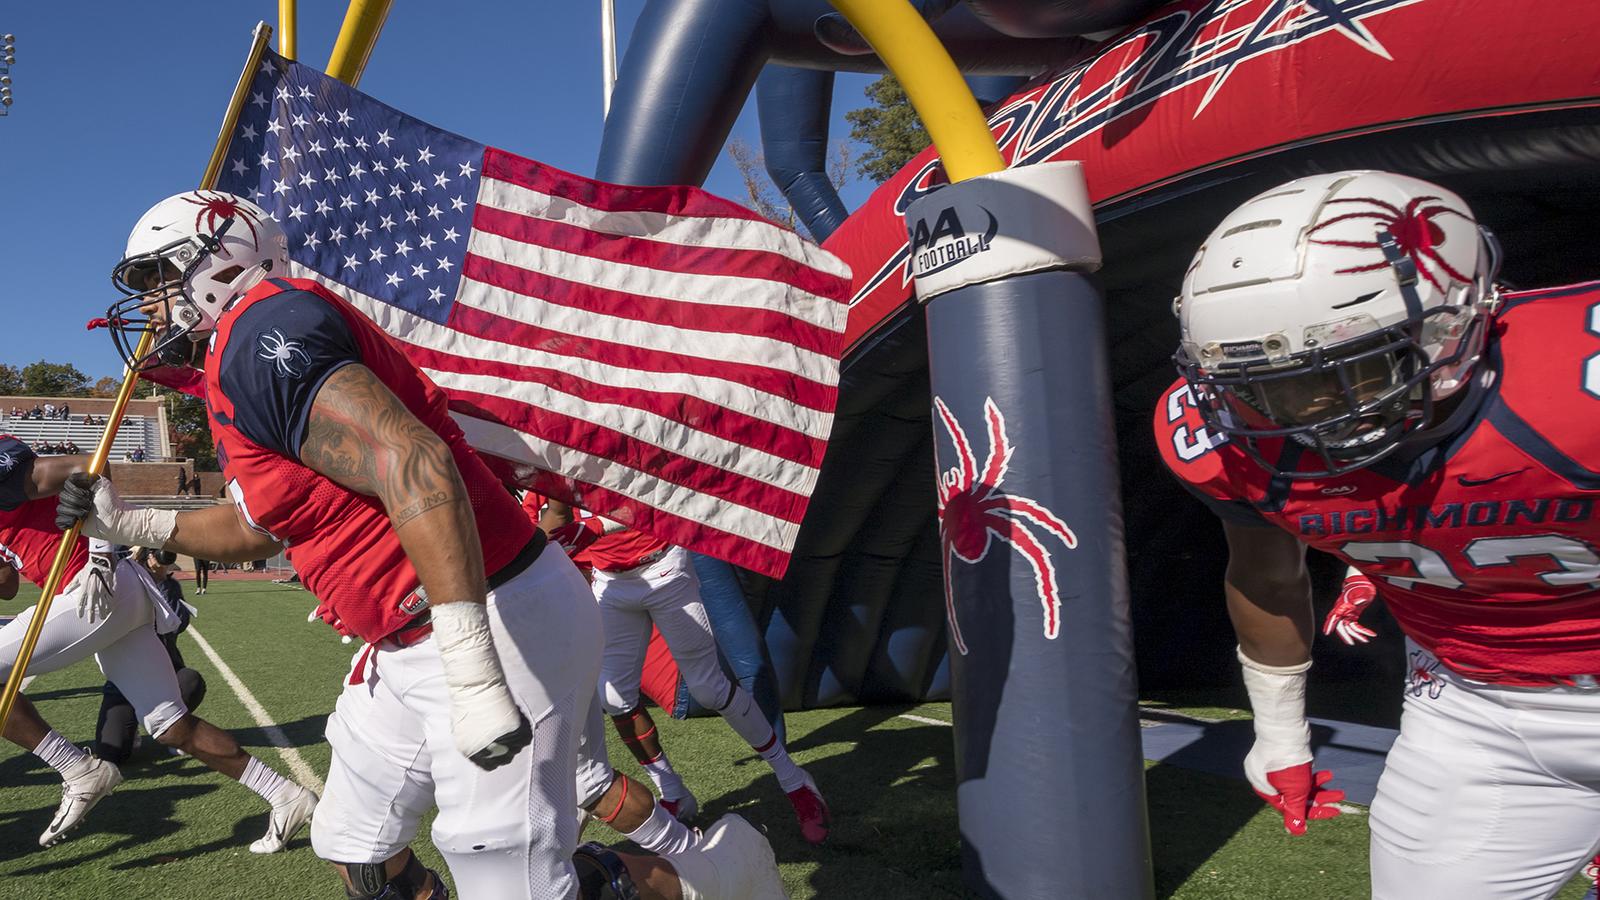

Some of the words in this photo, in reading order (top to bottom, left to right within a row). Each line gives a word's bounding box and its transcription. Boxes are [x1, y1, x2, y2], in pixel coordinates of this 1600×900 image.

[908, 206, 966, 257] AA
[918, 234, 991, 272] FOOTBALL
[1299, 498, 1595, 535] RICHMOND
